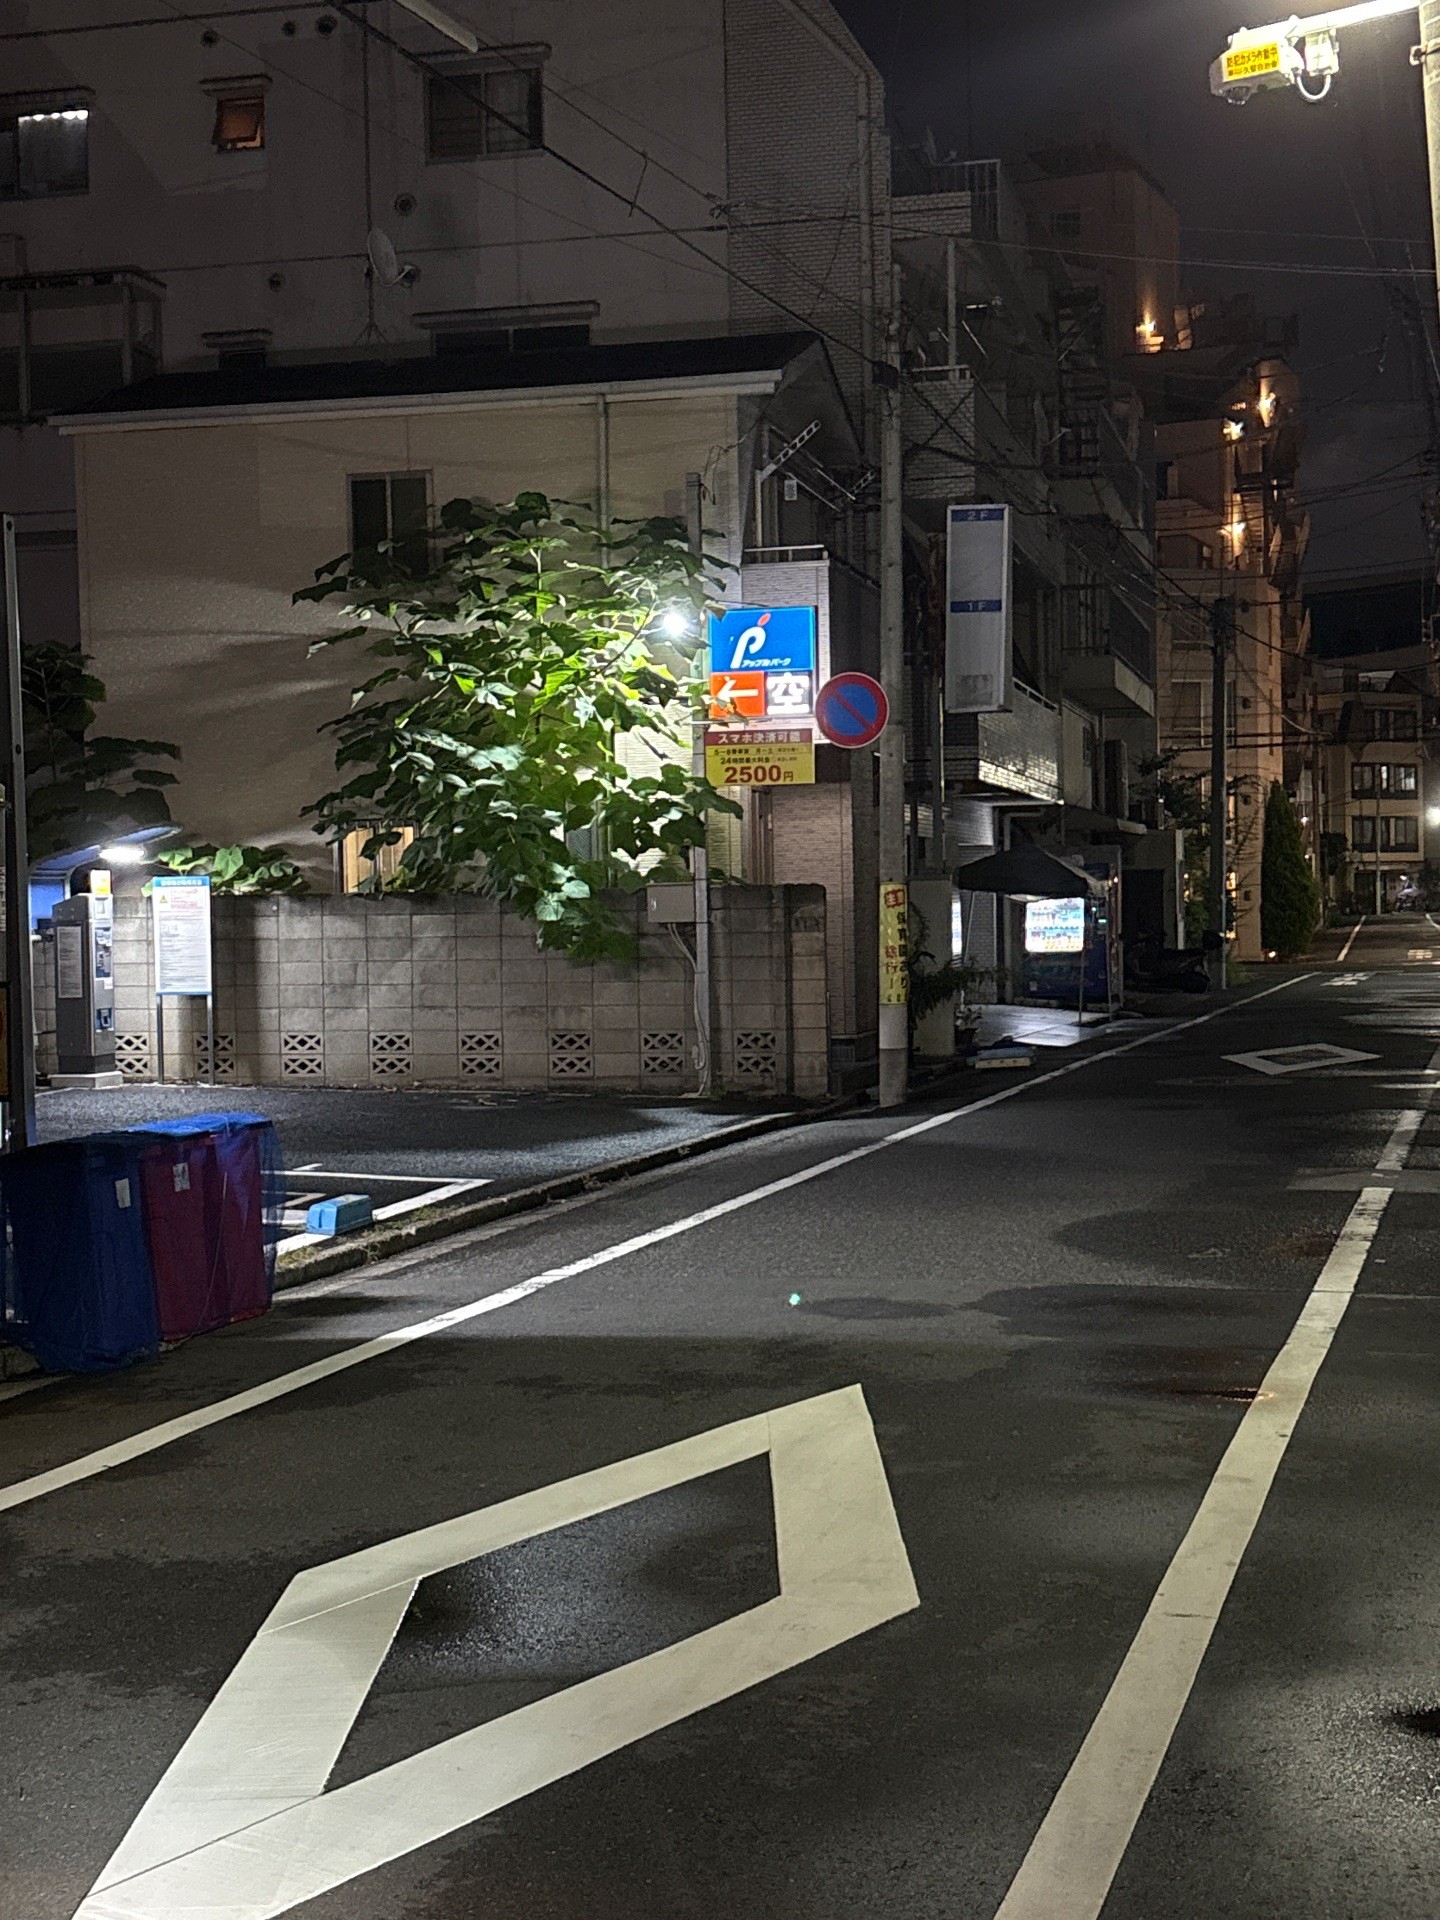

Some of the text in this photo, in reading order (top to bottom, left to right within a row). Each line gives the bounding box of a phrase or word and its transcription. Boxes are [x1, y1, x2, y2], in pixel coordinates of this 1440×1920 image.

[966, 510, 989, 520] 2F
[967, 601, 987, 611] 1F
[766, 672, 810, 715] 空
[718, 731, 801, 744] スマホ決済可能
